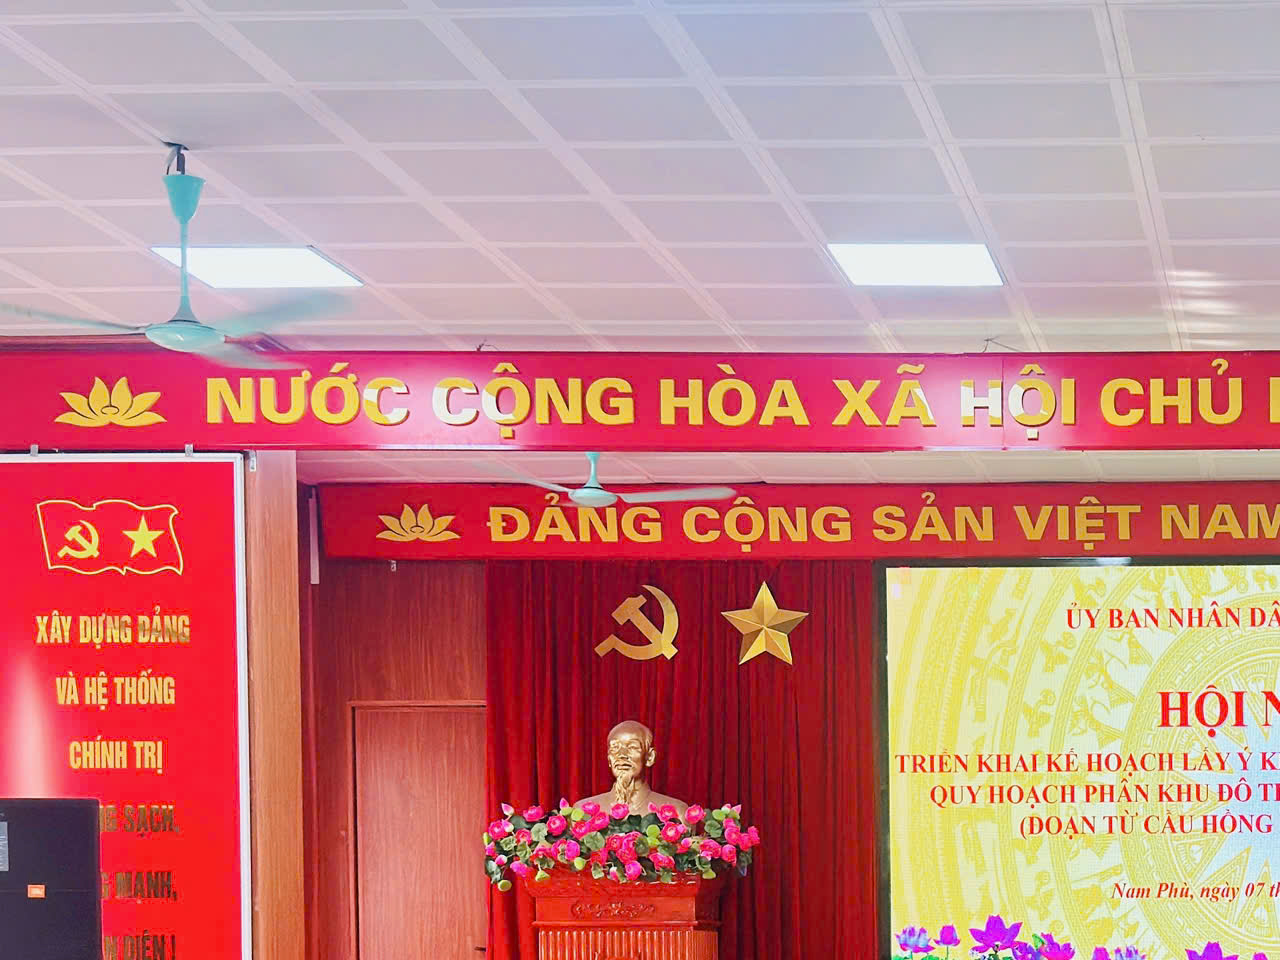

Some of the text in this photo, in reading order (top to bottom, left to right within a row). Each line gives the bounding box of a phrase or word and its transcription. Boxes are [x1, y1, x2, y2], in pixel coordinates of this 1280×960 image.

[206, 362, 410, 426] NƯỚC
[432, 362, 635, 440] CỘNG
[660, 362, 810, 427] HÒA
[831, 364, 936, 427] XÃ
[961, 363, 1077, 439] HỘI
[1100, 358, 1243, 428] CHỦ
[488, 492, 662, 544] ĐẢNG
[682, 498, 852, 552] CỘNG
[872, 492, 994, 542] SẢN
[1015, 496, 1142, 552] VIỆT
[35, 606, 190, 649] XÂY DỰNG ĐẢNG
[1067, 602, 1101, 629] ỦY
[1109, 608, 1159, 628] BAN
[1169, 601, 1240, 628] NHÂN
[56, 669, 176, 710] VÀ HỆ THỐNG
[1157, 685, 1248, 738] HỘI
[69, 735, 162, 774] CHÍNH TRỊ
[895, 749, 969, 773] TRIỂN
[977, 753, 1038, 773] KHAI
[1047, 748, 1080, 773] KẾ
[1087, 753, 1175, 776] HOẠCH
[1183, 748, 1230, 771] LẤY
[1238, 747, 1258, 771] Ý
[930, 785, 982, 808] QUY
[989, 785, 1075, 809] HOẠCH
[1085, 778, 1149, 803] PHÂN
[1158, 784, 1210, 803] KHU
[1218, 777, 1252, 802] ĐÔ
[123, 805, 180, 838] SẠCH,
[1020, 815, 1096, 840] (ĐOẠN
[1103, 811, 1137, 834] TỪ
[1143, 809, 1193, 834] CẦU
[1202, 810, 1273, 834] HỒNG
[116, 872, 178, 904] MẠNH,
[1112, 882, 1151, 899] Nam
[1157, 880, 1194, 902] Phù,
[1200, 884, 1239, 902] ngày
[1245, 882, 1265, 898] 07
